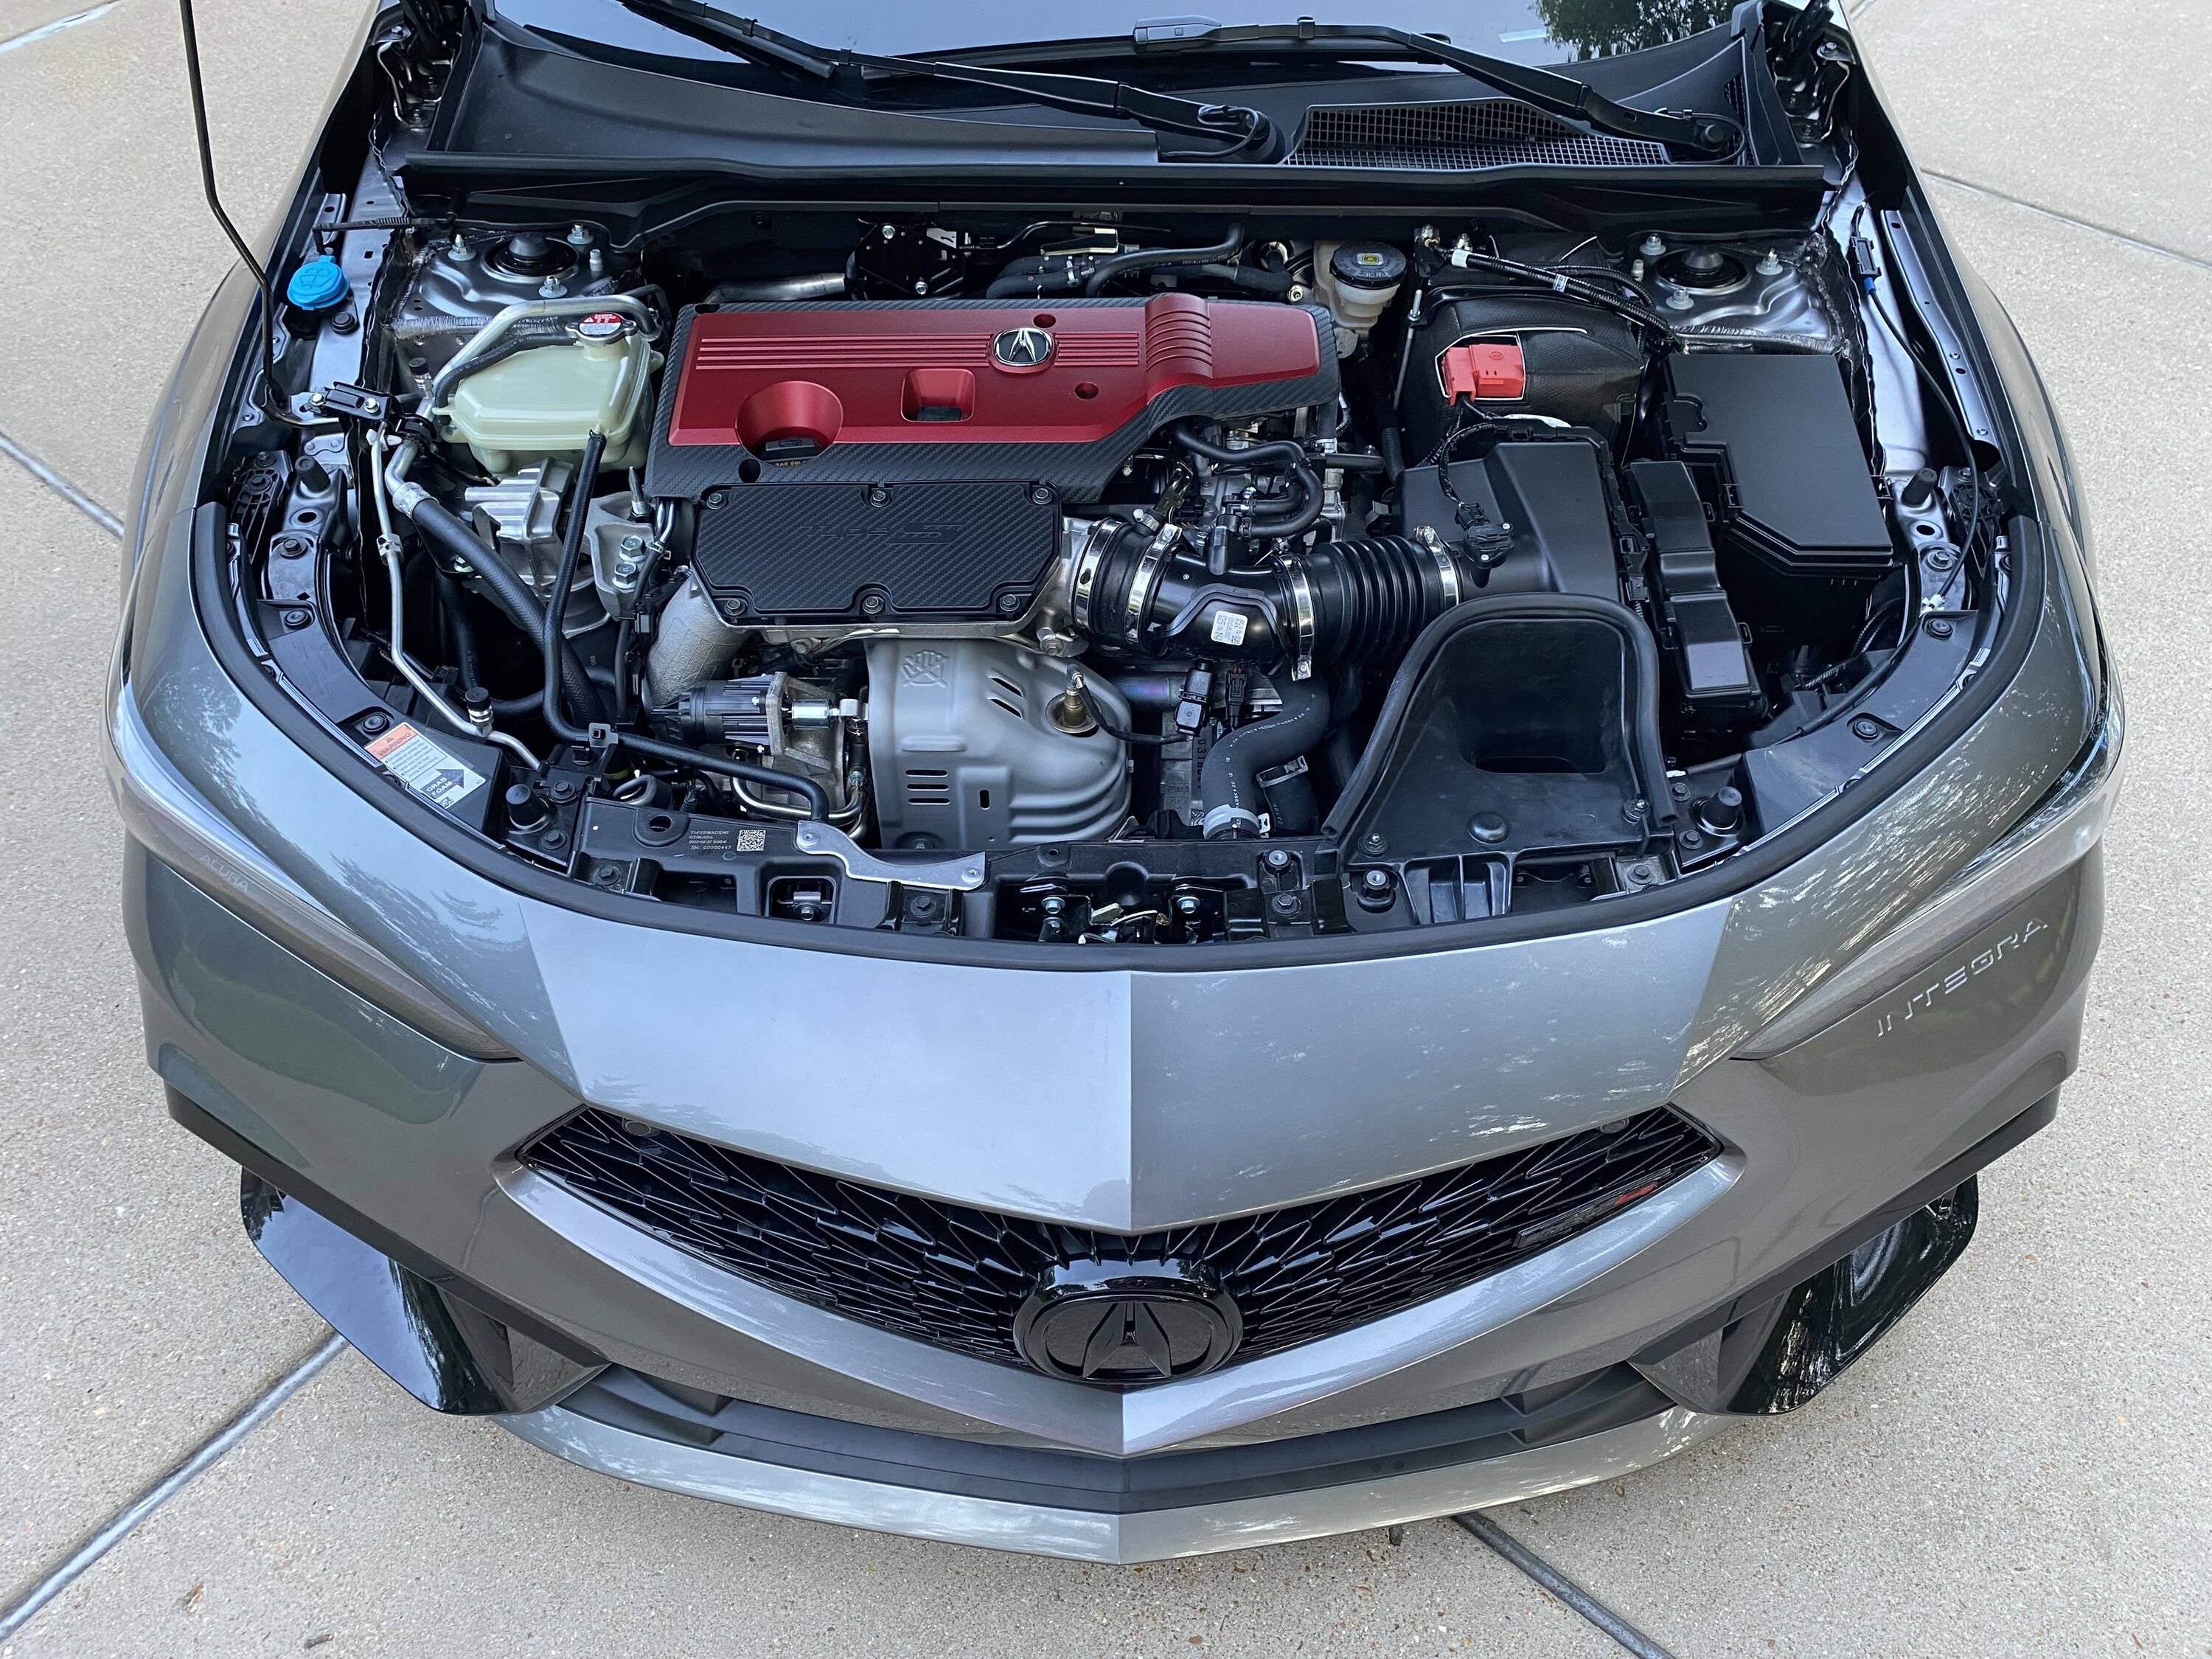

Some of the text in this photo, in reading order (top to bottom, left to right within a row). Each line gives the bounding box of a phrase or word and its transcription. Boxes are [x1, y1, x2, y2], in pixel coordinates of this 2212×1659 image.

[378, 732, 411, 757] WARNING
[426, 777, 448, 793] GRAB
[431, 781, 453, 796] FOAM
[198, 854, 249, 894] ACURA
[1877, 917, 2048, 1037] INTEGRA
